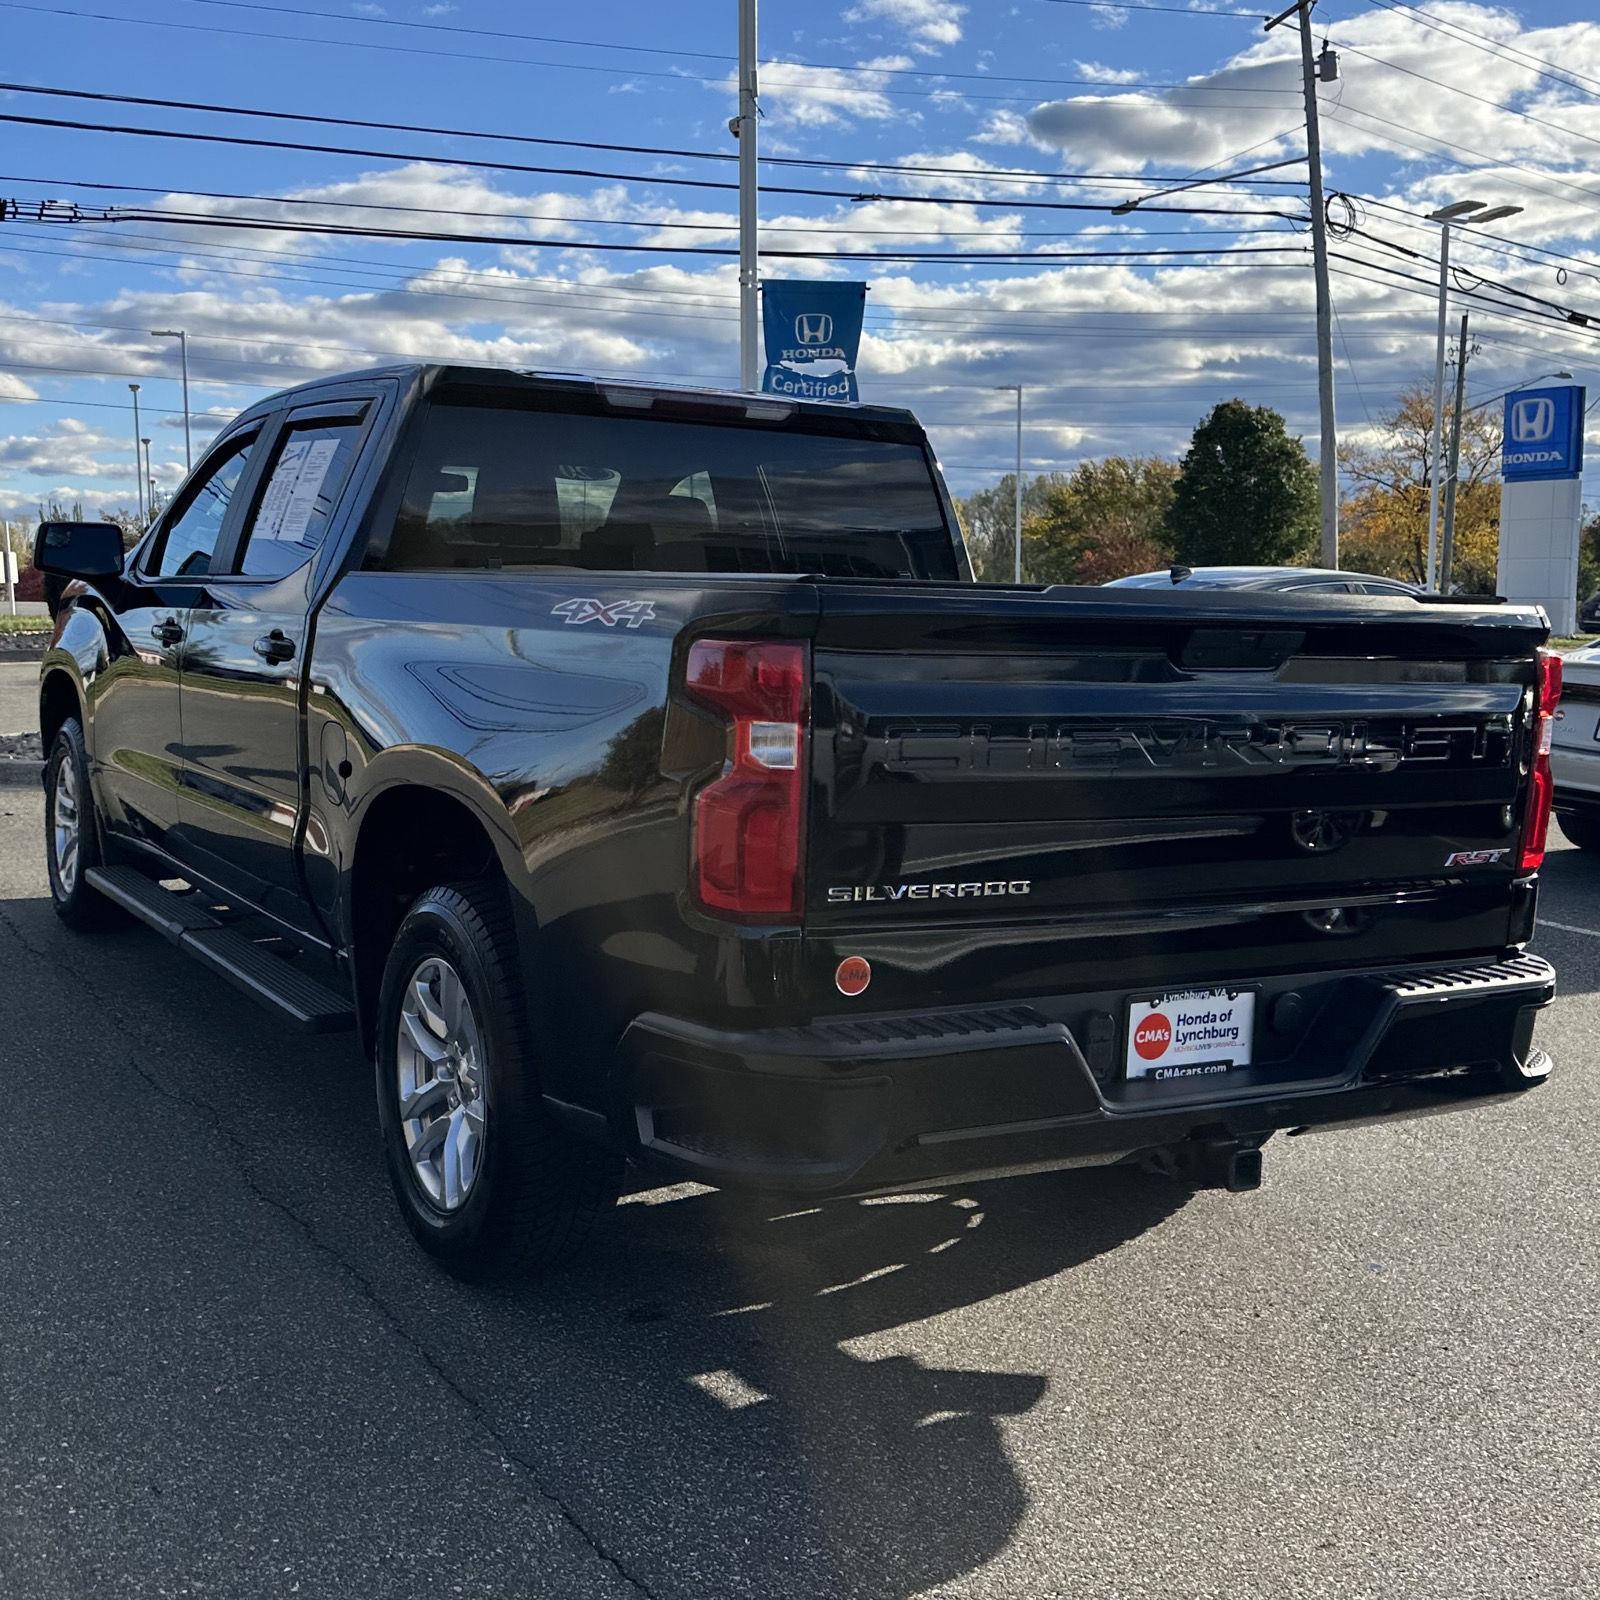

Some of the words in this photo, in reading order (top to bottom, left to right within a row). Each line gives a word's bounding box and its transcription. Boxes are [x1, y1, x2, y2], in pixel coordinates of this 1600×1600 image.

[781, 347, 846, 359] HONDA
[772, 374, 850, 397] Certified
[1503, 450, 1563, 465] HONDA
[884, 720, 1513, 769] CHEVROLET
[1444, 847, 1511, 867] RST
[827, 879, 1032, 902] SILVERADO
[1214, 988, 1228, 999] VA
[1176, 1011, 1217, 1027] Honda
[1219, 1009, 1233, 1023] of
[1136, 1029, 1170, 1044] CMA's
[1175, 1026, 1239, 1045] Lynchburg
[1155, 1063, 1228, 1081] CMAcars.com
